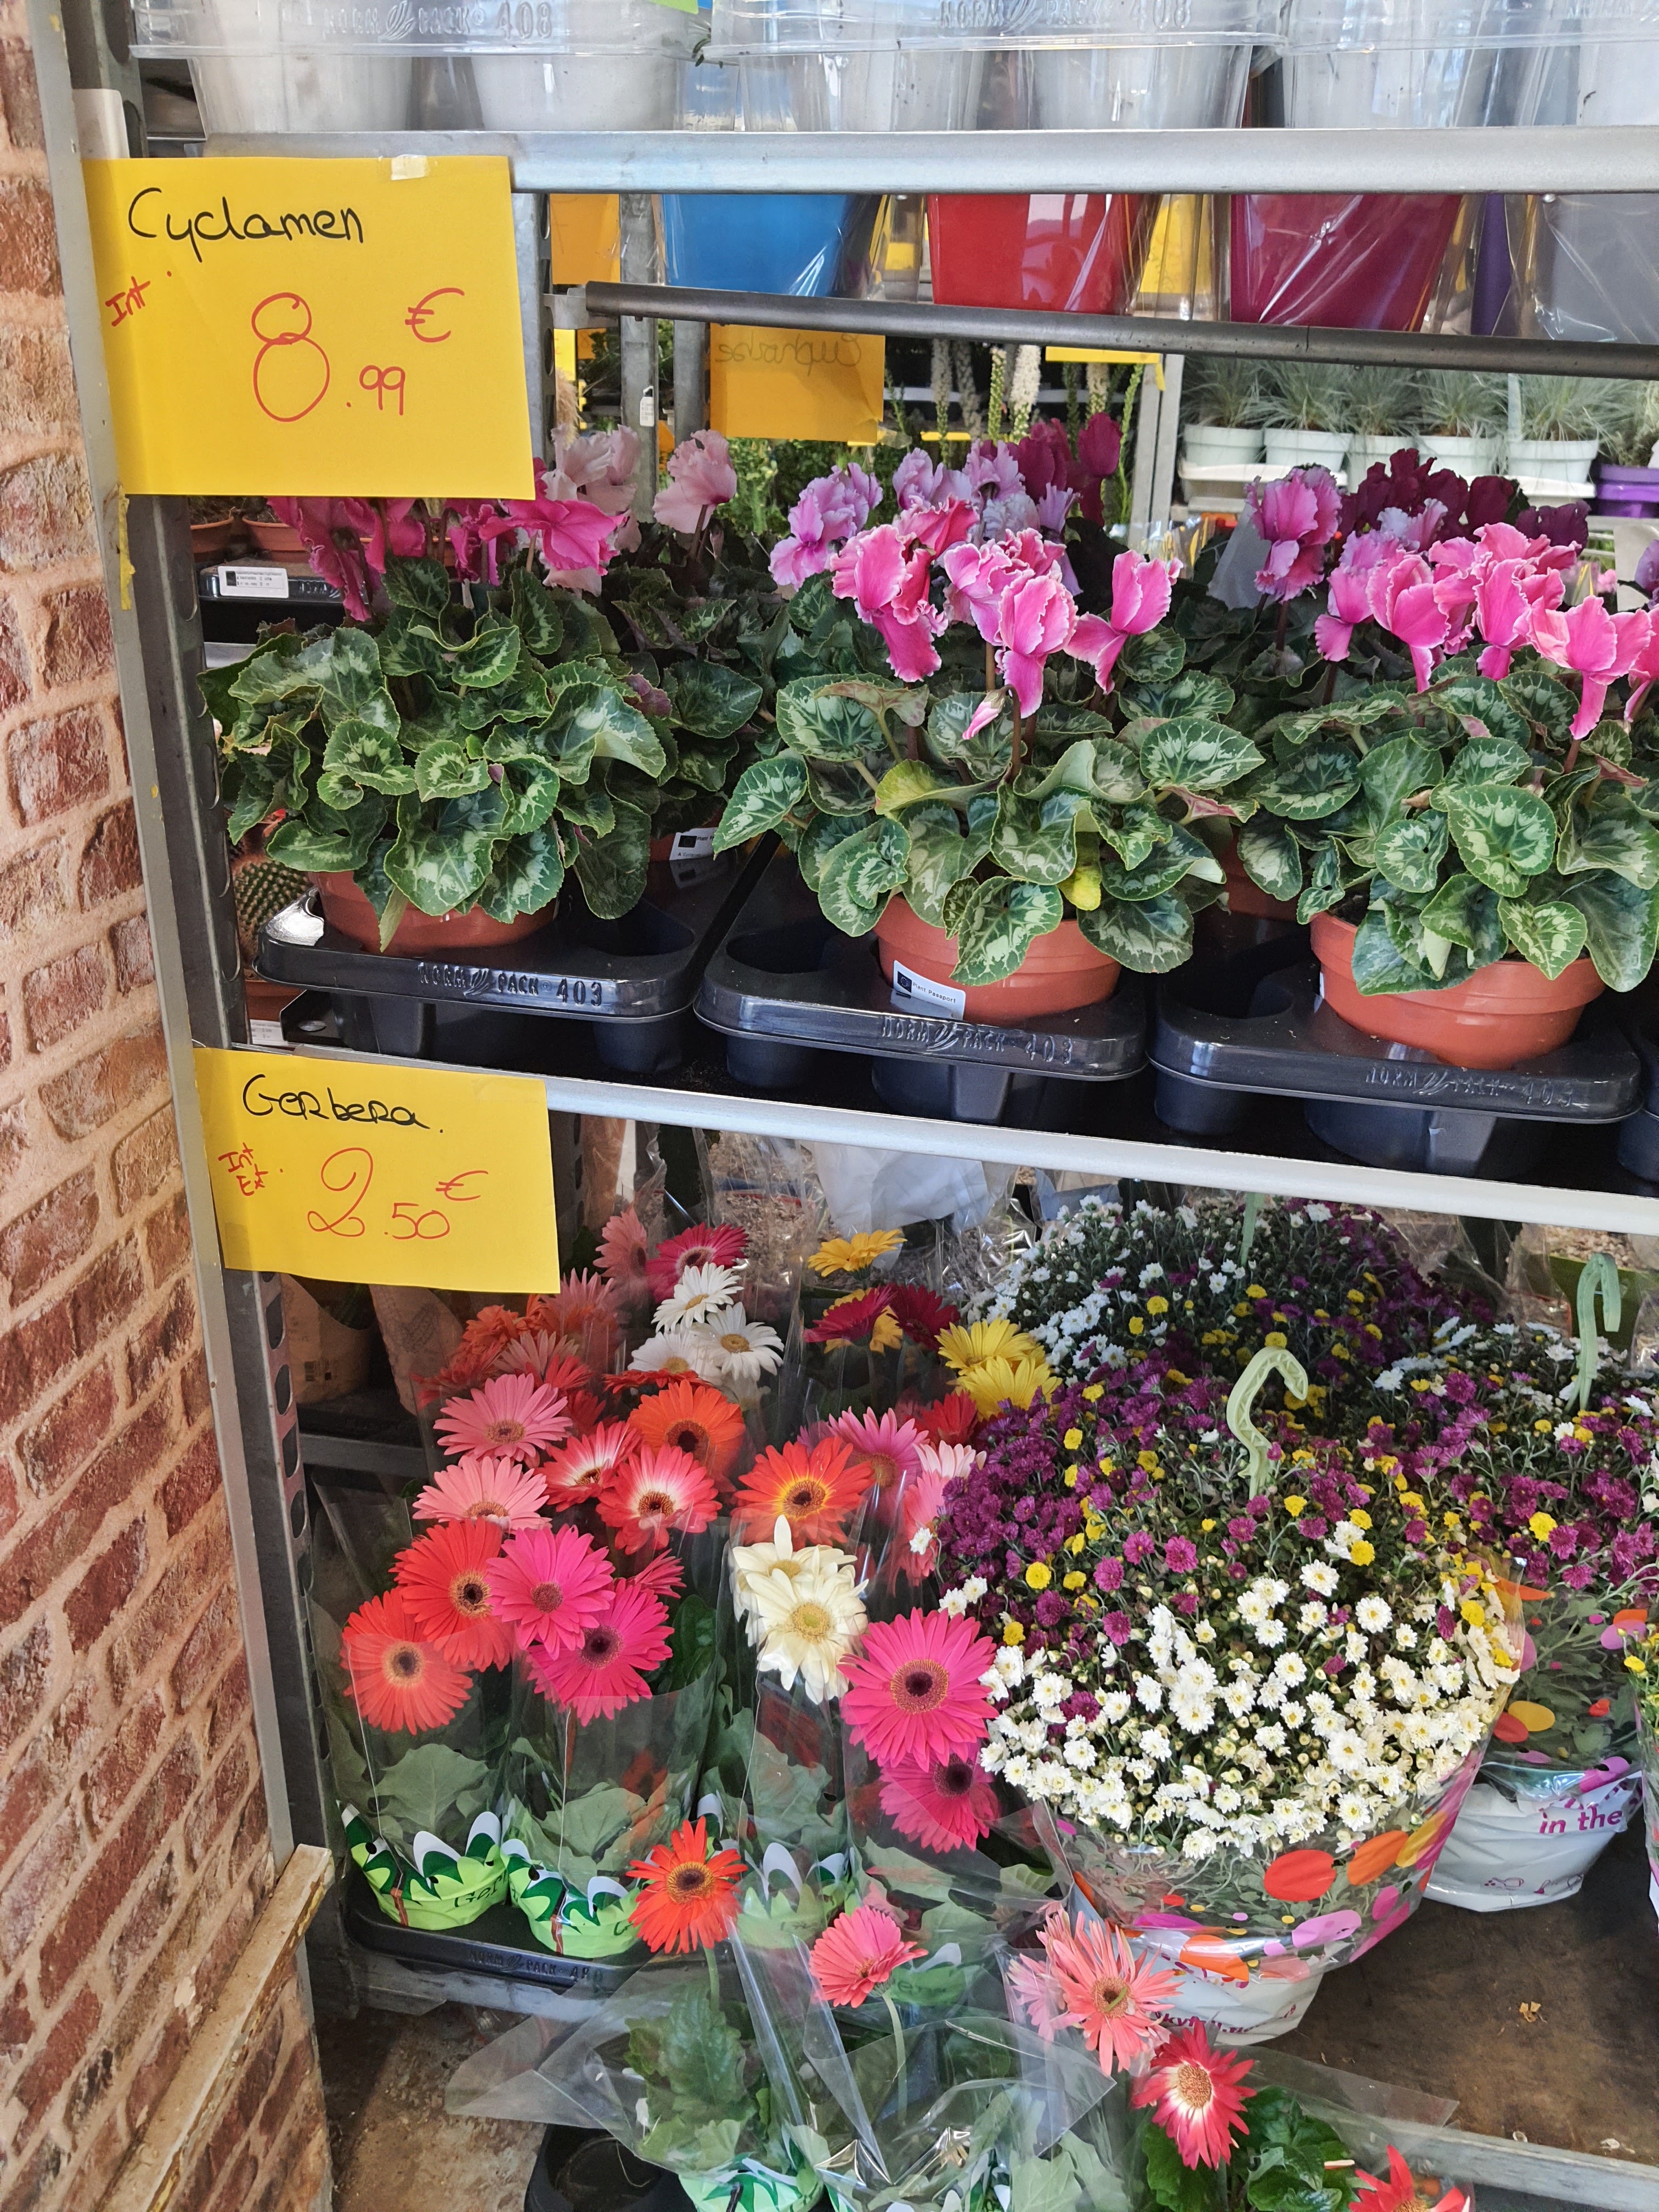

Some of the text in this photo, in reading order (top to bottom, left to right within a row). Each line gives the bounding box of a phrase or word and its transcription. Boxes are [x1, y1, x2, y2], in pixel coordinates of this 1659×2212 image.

[495, 1, 552, 41] 408
[128, 187, 364, 263] Cyclamen
[404, 287, 466, 343] €
[497, 970, 539, 996] PACK
[556, 977, 602, 1007] 403
[913, 982, 956, 1003] Plant Passport
[307, 1147, 489, 1240] 2.50 €
[1539, 1803, 1623, 1835] in the
